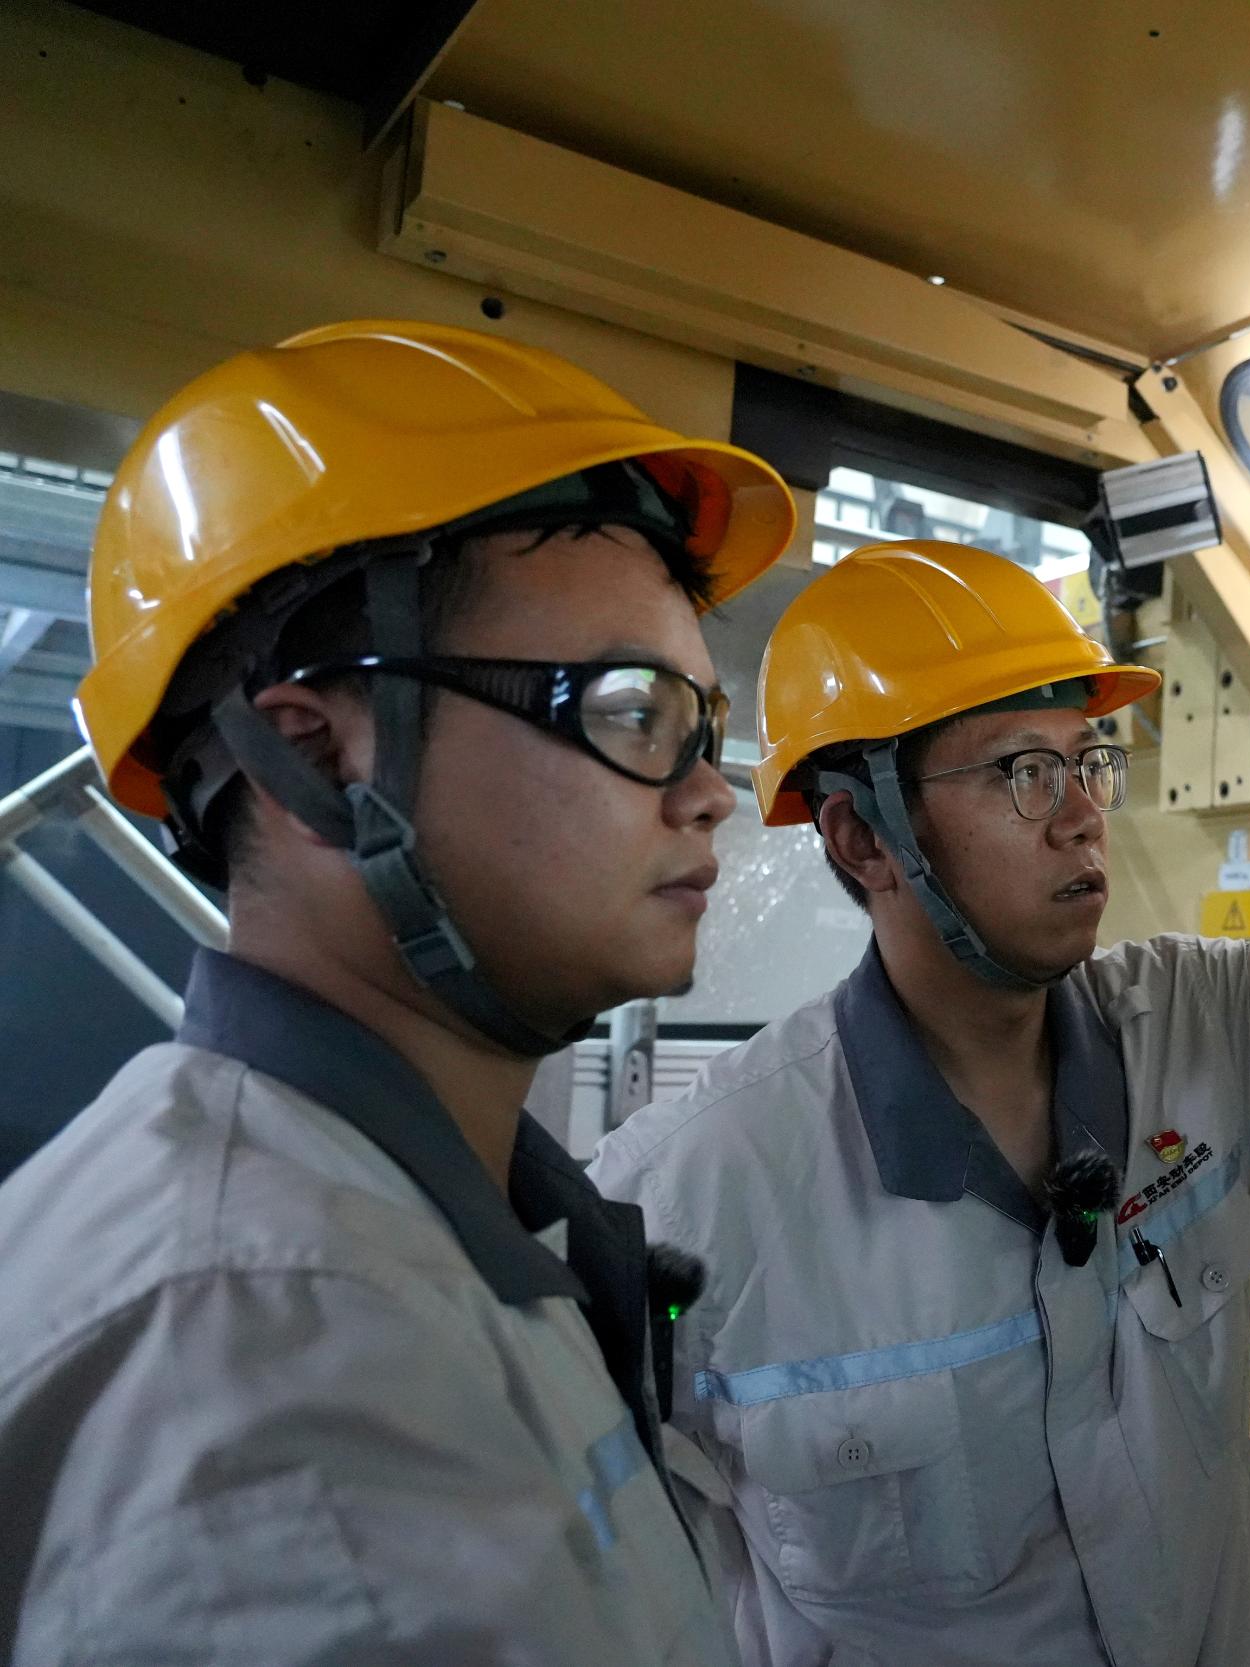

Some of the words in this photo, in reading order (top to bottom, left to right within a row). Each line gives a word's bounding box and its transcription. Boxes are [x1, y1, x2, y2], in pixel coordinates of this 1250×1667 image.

[1142, 1142, 1211, 1197] 西安动车段
[1171, 1174, 1187, 1189] EMU
[1188, 1151, 1213, 1174] DEPOT
